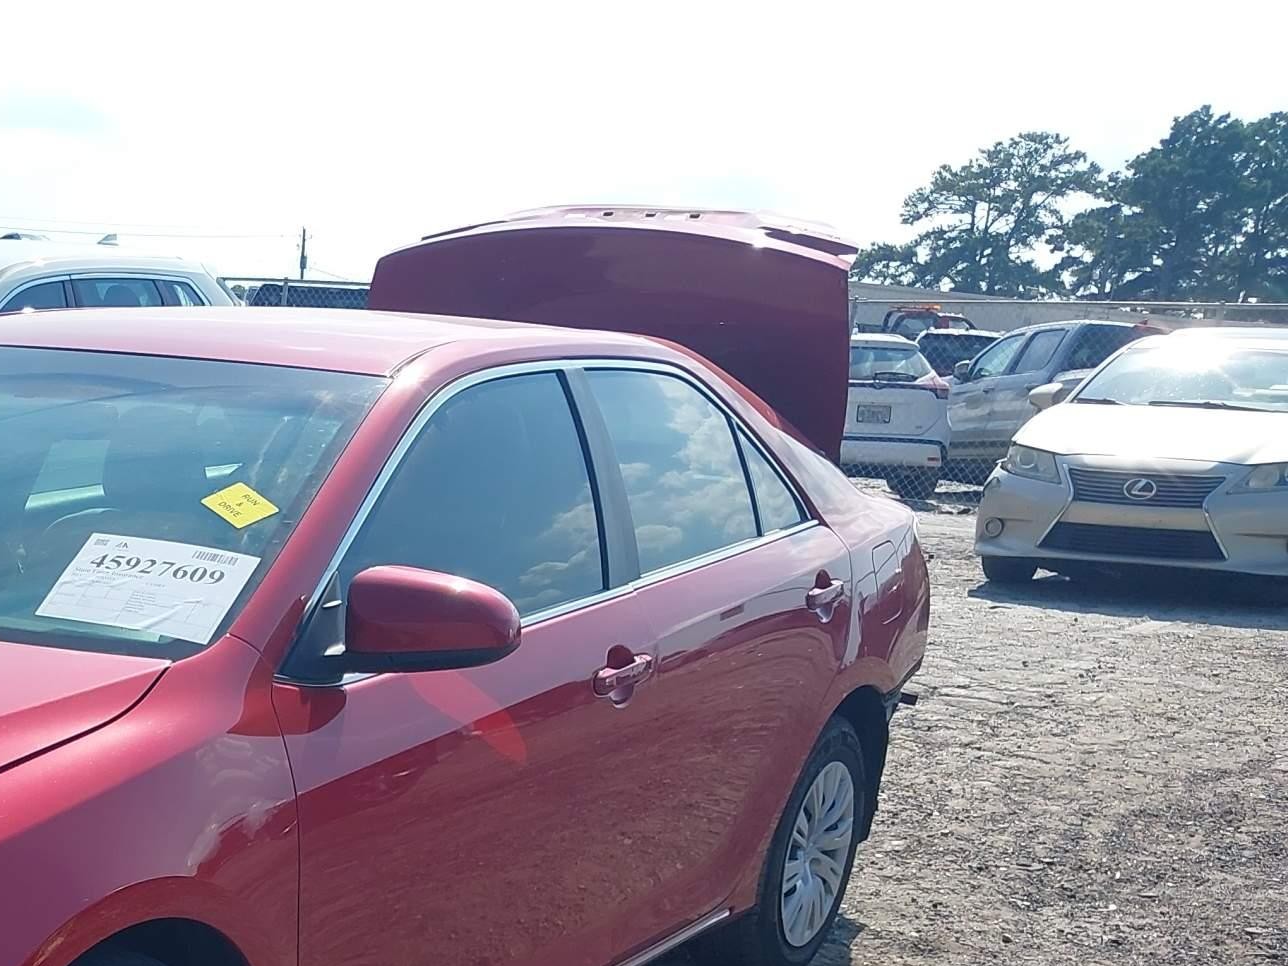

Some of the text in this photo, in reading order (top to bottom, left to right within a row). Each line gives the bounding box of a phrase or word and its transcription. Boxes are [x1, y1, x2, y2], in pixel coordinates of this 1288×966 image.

[242, 494, 260, 506] RUN
[218, 501, 242, 518] DRIVE
[90, 553, 225, 585] 45927609
